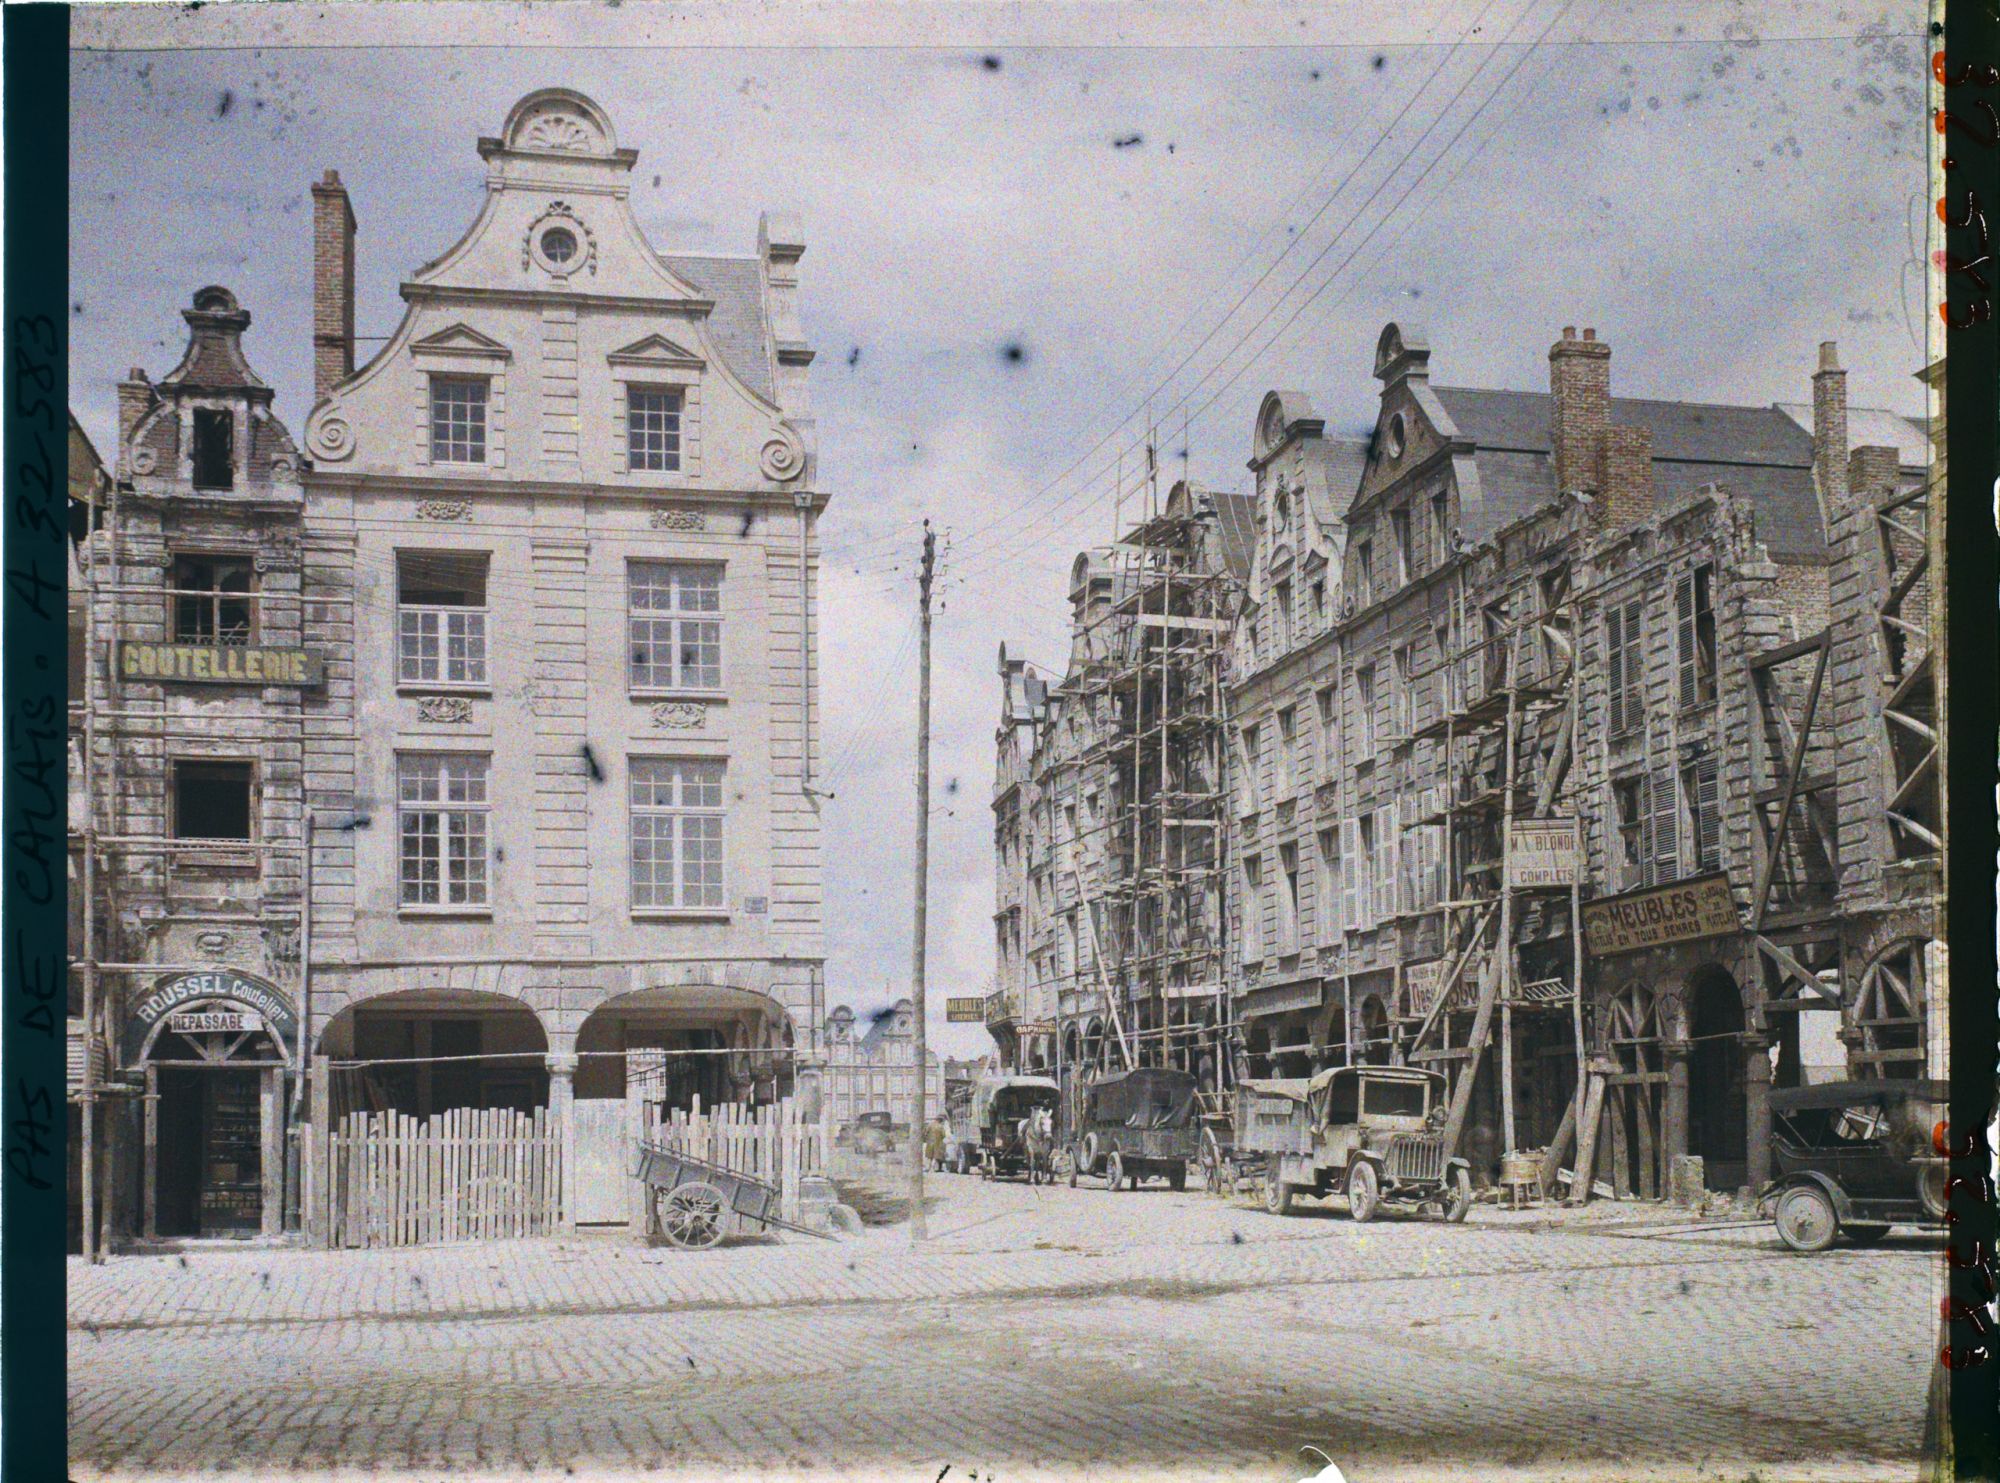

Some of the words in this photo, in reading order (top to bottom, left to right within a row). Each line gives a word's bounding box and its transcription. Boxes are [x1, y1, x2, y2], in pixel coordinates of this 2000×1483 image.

[124, 645, 308, 682] COUTELLERIE
[9, 695, 57, 904] CALAIS
[1520, 869, 1574, 882] COMPLETS
[1608, 889, 1698, 931] MEUBLES
[1634, 928, 1658, 944] TOUS
[1664, 920, 1701, 937] GENRES
[17, 929, 57, 1038] DE
[136, 976, 228, 1024] ROUSSEL
[231, 979, 289, 1022] Coutelier
[173, 1014, 244, 1031] REPASSAGE
[6, 1077, 54, 1191] PAS
